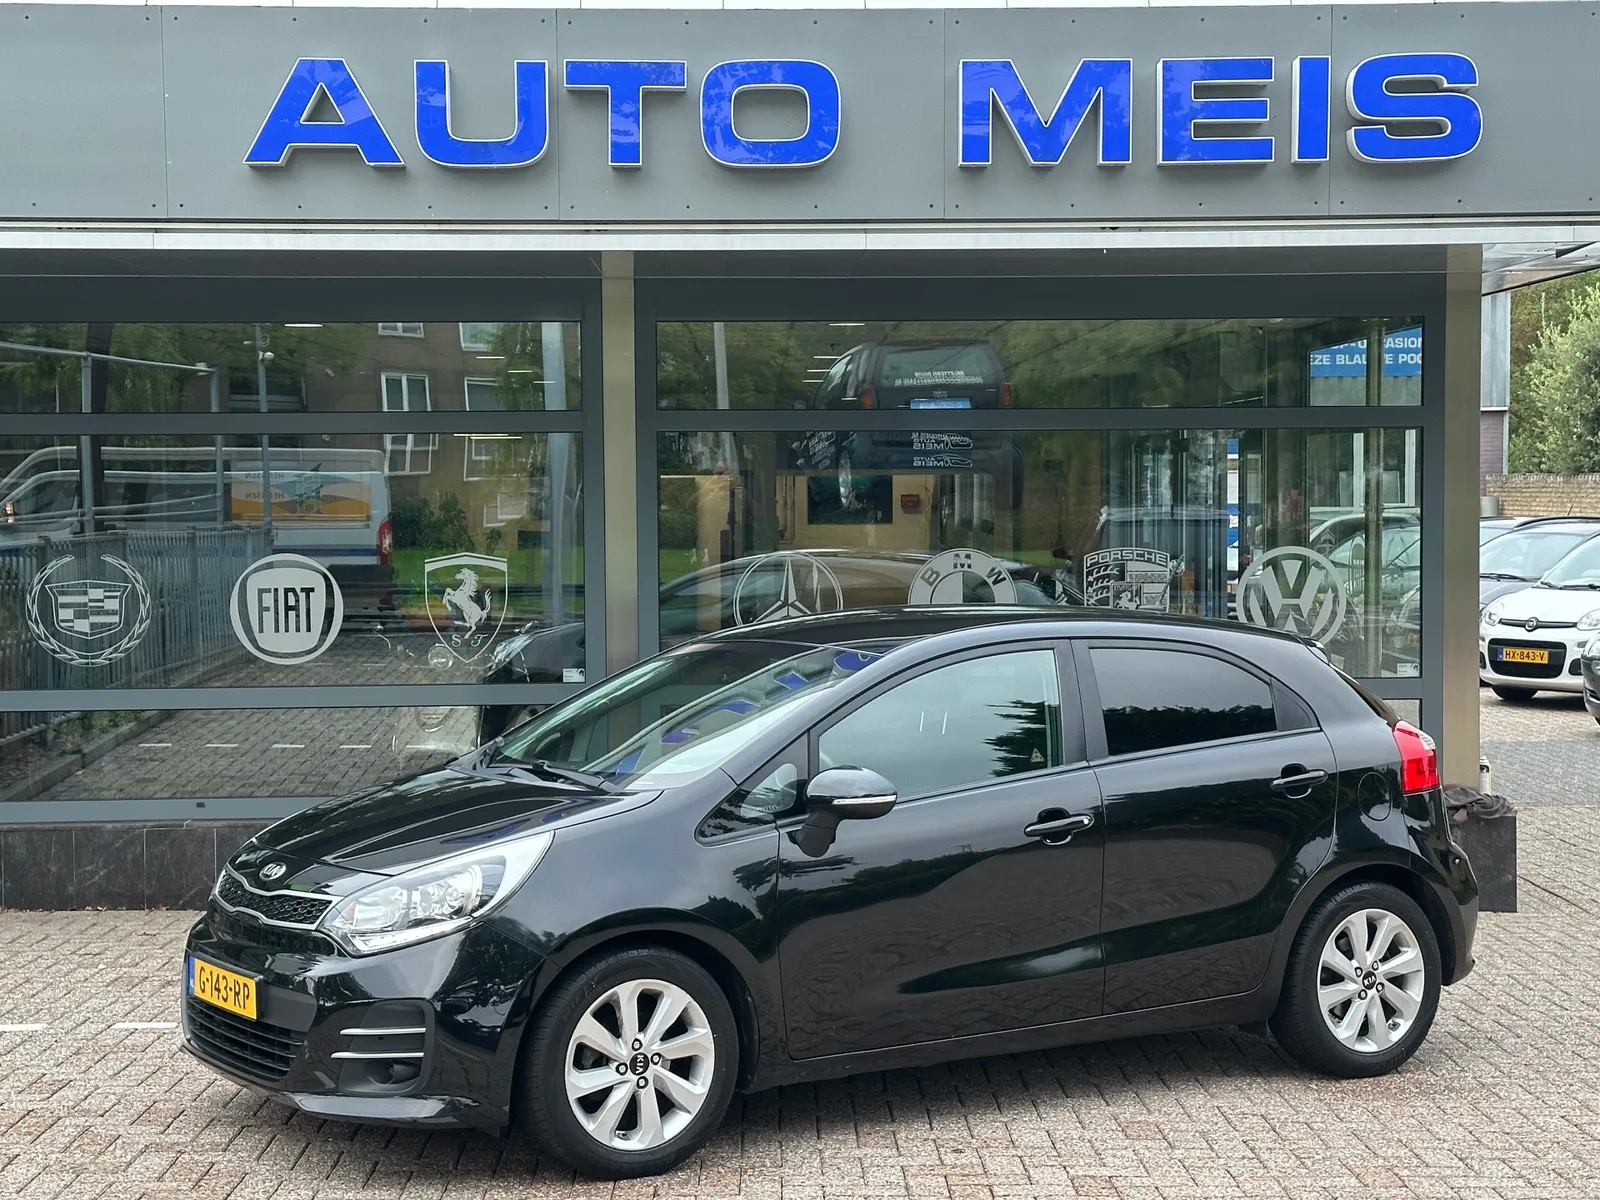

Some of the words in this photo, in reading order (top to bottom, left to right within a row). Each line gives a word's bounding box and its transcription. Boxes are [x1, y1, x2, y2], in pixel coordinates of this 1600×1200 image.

[242, 57, 841, 170] AUTO
[957, 52, 1484, 168] MEIS
[1086, 550, 1168, 567] PORSCHE
[257, 587, 315, 634] FIAT
[1504, 650, 1545, 661] HX-843-V
[199, 965, 250, 1010] G-143-RP
[1363, 975, 1377, 987] KIA
[635, 1054, 645, 1075] KIA
